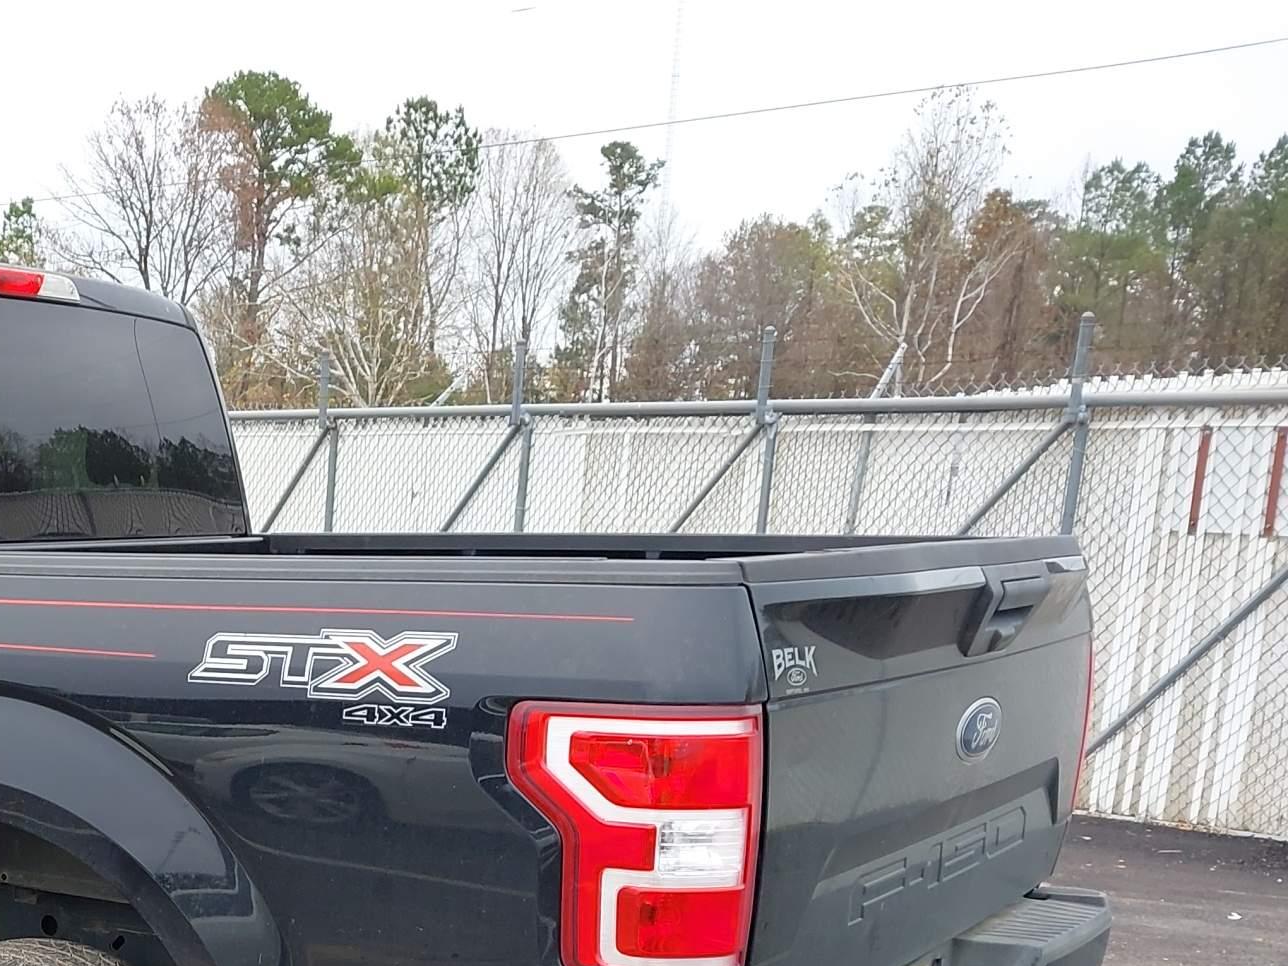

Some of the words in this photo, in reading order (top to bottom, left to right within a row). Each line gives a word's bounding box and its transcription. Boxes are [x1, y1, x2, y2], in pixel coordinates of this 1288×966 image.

[187, 628, 459, 704] STX
[772, 645, 818, 680] BELK
[972, 711, 998, 749] Ford
[847, 806, 1027, 927] F-150
